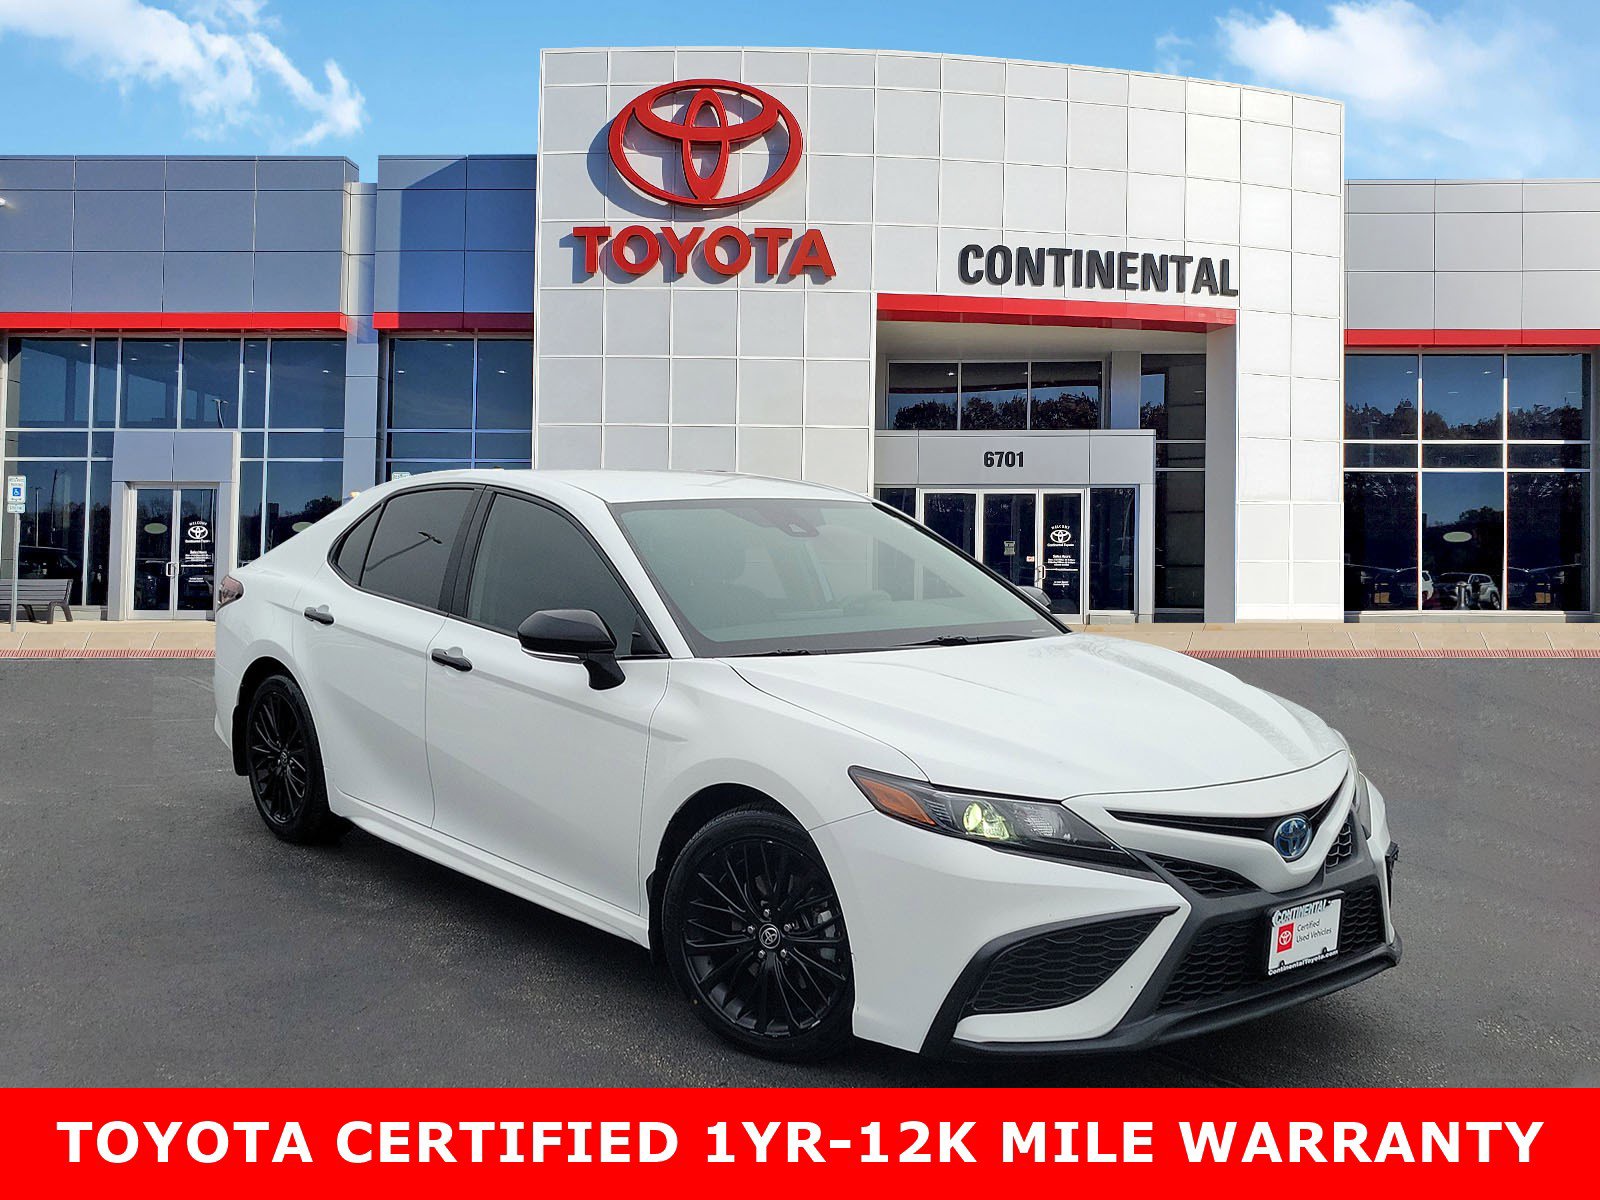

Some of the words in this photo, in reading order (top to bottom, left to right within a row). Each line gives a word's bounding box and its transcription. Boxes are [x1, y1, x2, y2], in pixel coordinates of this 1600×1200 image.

[573, 226, 836, 278] TOYOTA
[958, 244, 1240, 297] CONTINENTAL
[984, 451, 1024, 468] 6701
[1272, 899, 1326, 926] CONTINENTAL
[1297, 919, 1321, 932] Certified
[1296, 934, 1310, 943] Used
[1310, 928, 1332, 938] Vehicles
[1268, 950, 1338, 976] ContinentalToyota.com
